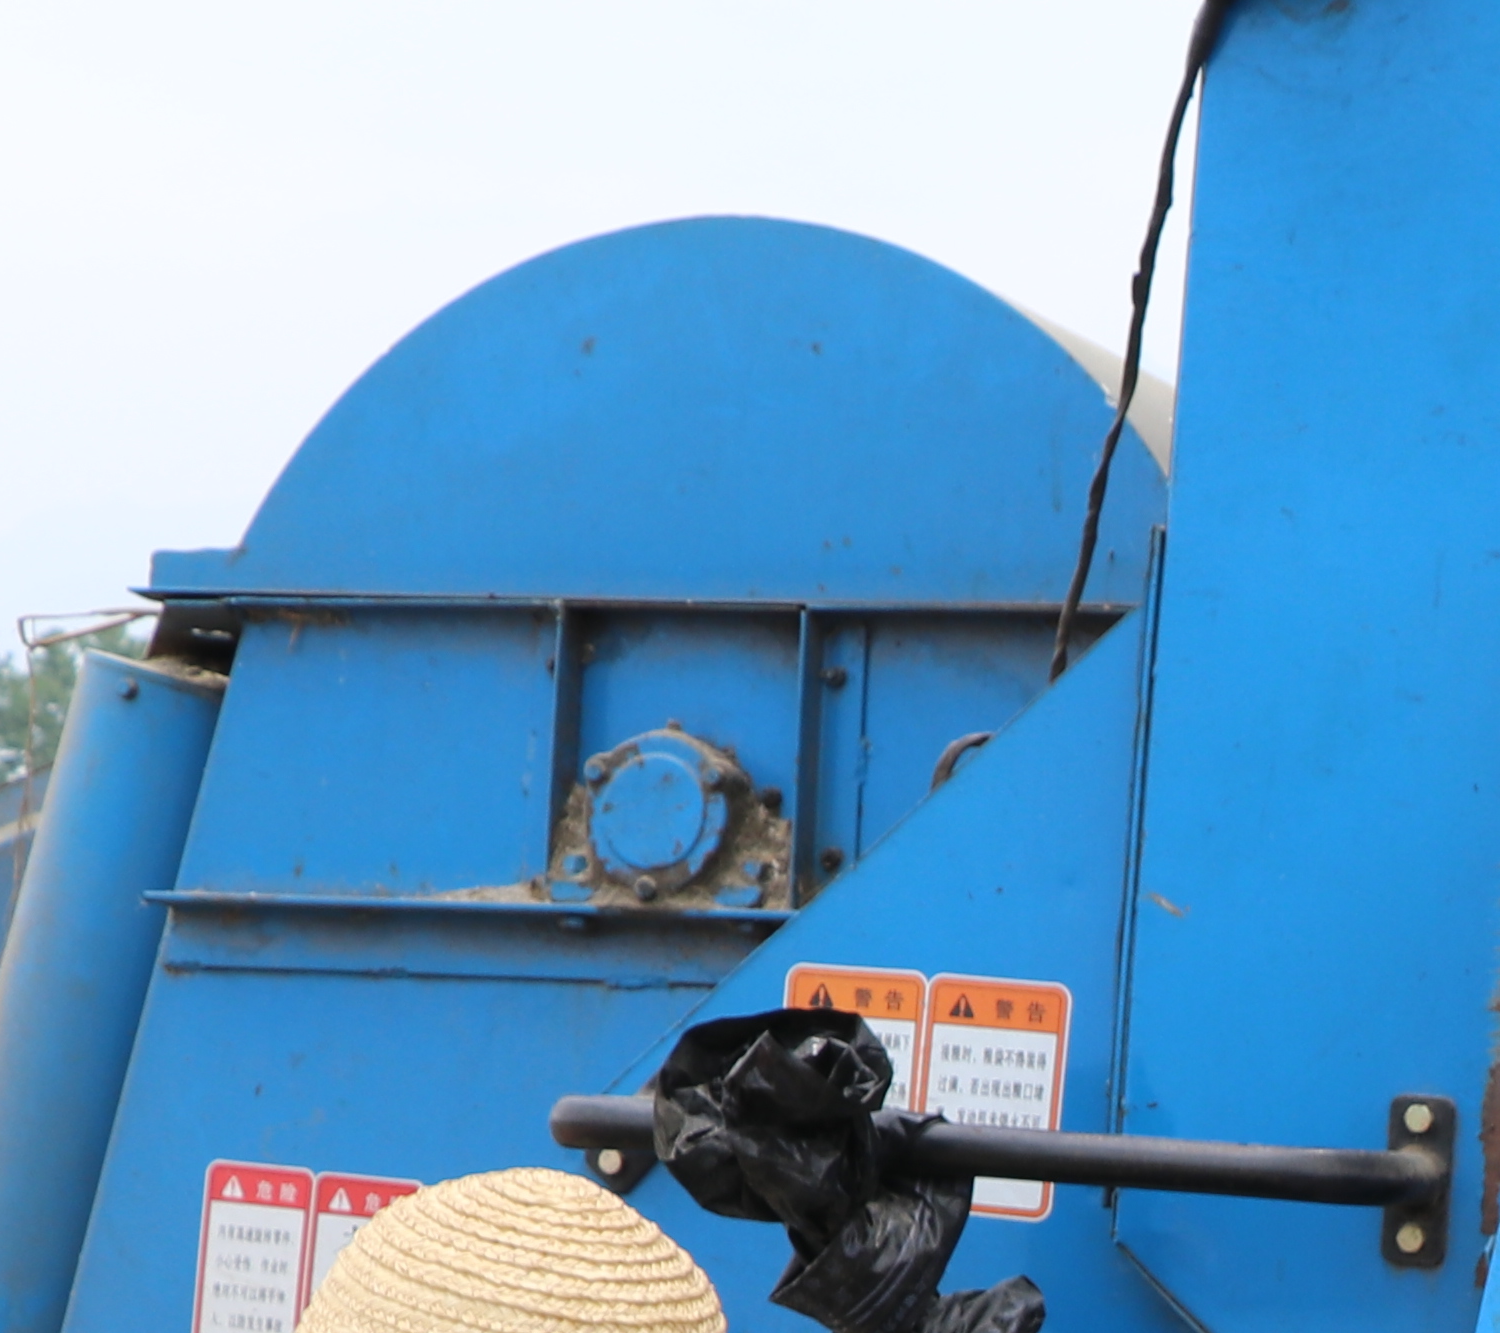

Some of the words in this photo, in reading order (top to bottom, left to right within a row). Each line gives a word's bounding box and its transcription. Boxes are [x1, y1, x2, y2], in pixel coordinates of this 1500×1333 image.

[855, 986, 905, 1012] 警告
[995, 999, 1047, 1024] 警告
[256, 1180, 299, 1202] 危险
